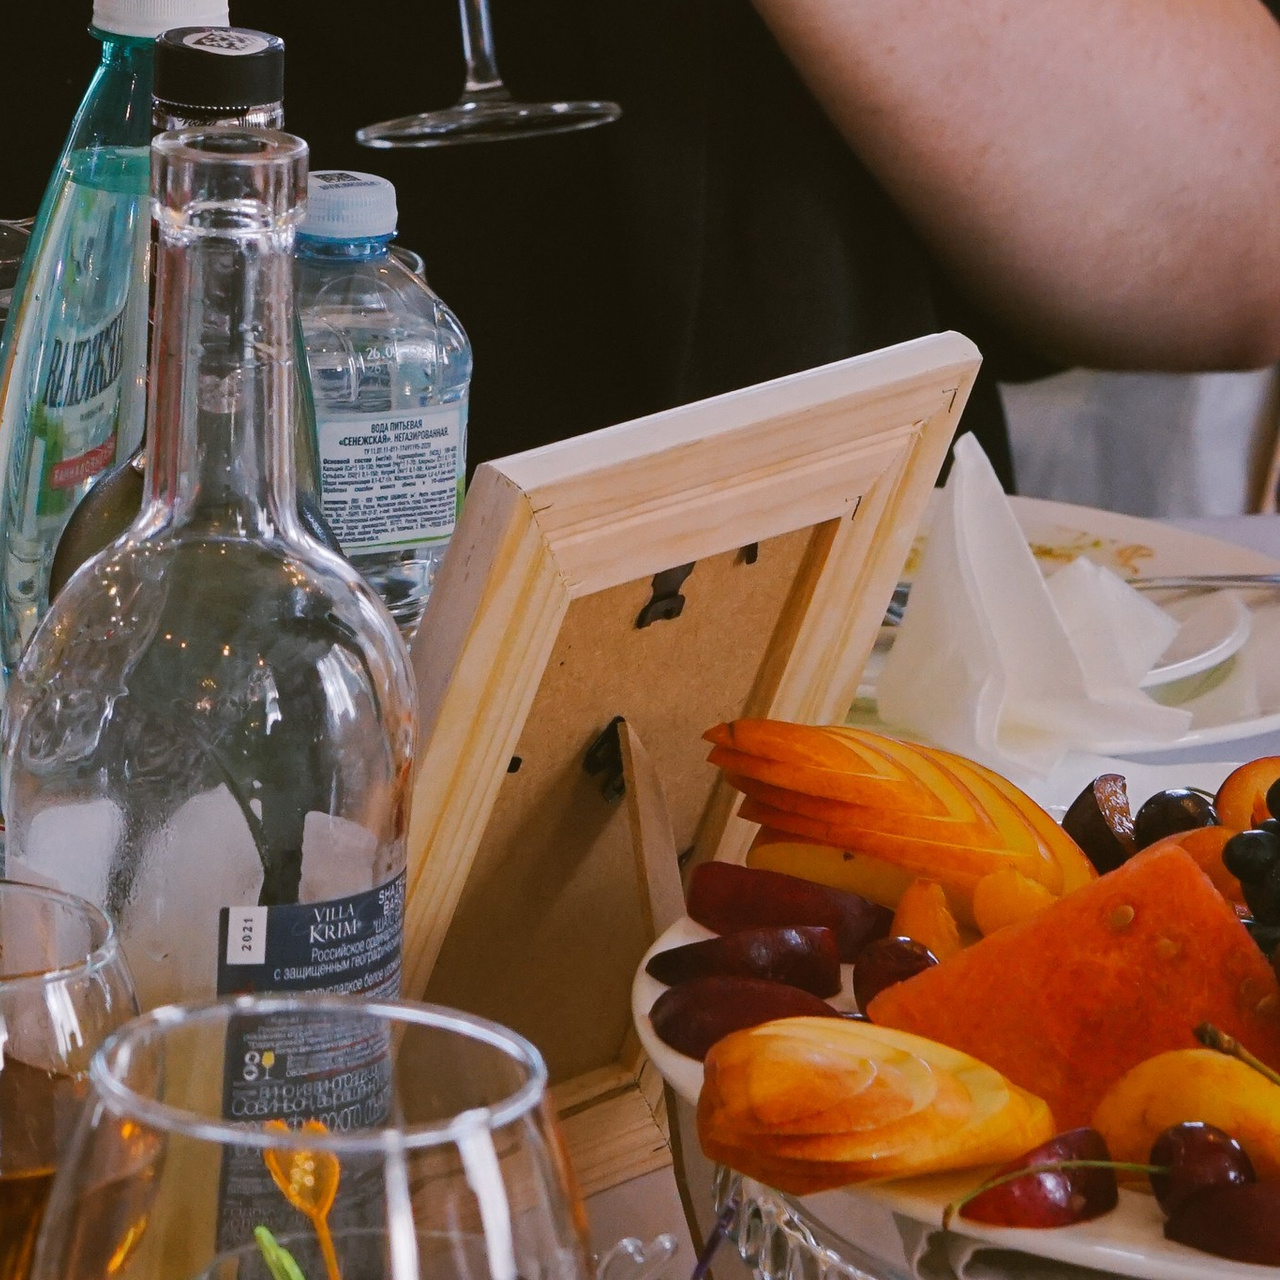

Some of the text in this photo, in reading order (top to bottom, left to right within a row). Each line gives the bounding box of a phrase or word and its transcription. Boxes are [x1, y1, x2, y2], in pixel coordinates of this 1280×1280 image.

[371, 419, 423, 434] ВОДА ПИТЬЕВАЯ
[314, 903, 355, 923] VILLA
[241, 918, 253, 952] 2021
[309, 918, 358, 944] KRIM
[311, 940, 365, 963] Российское
[274, 969, 281, 981] с
[284, 958, 351, 981] защищенным
